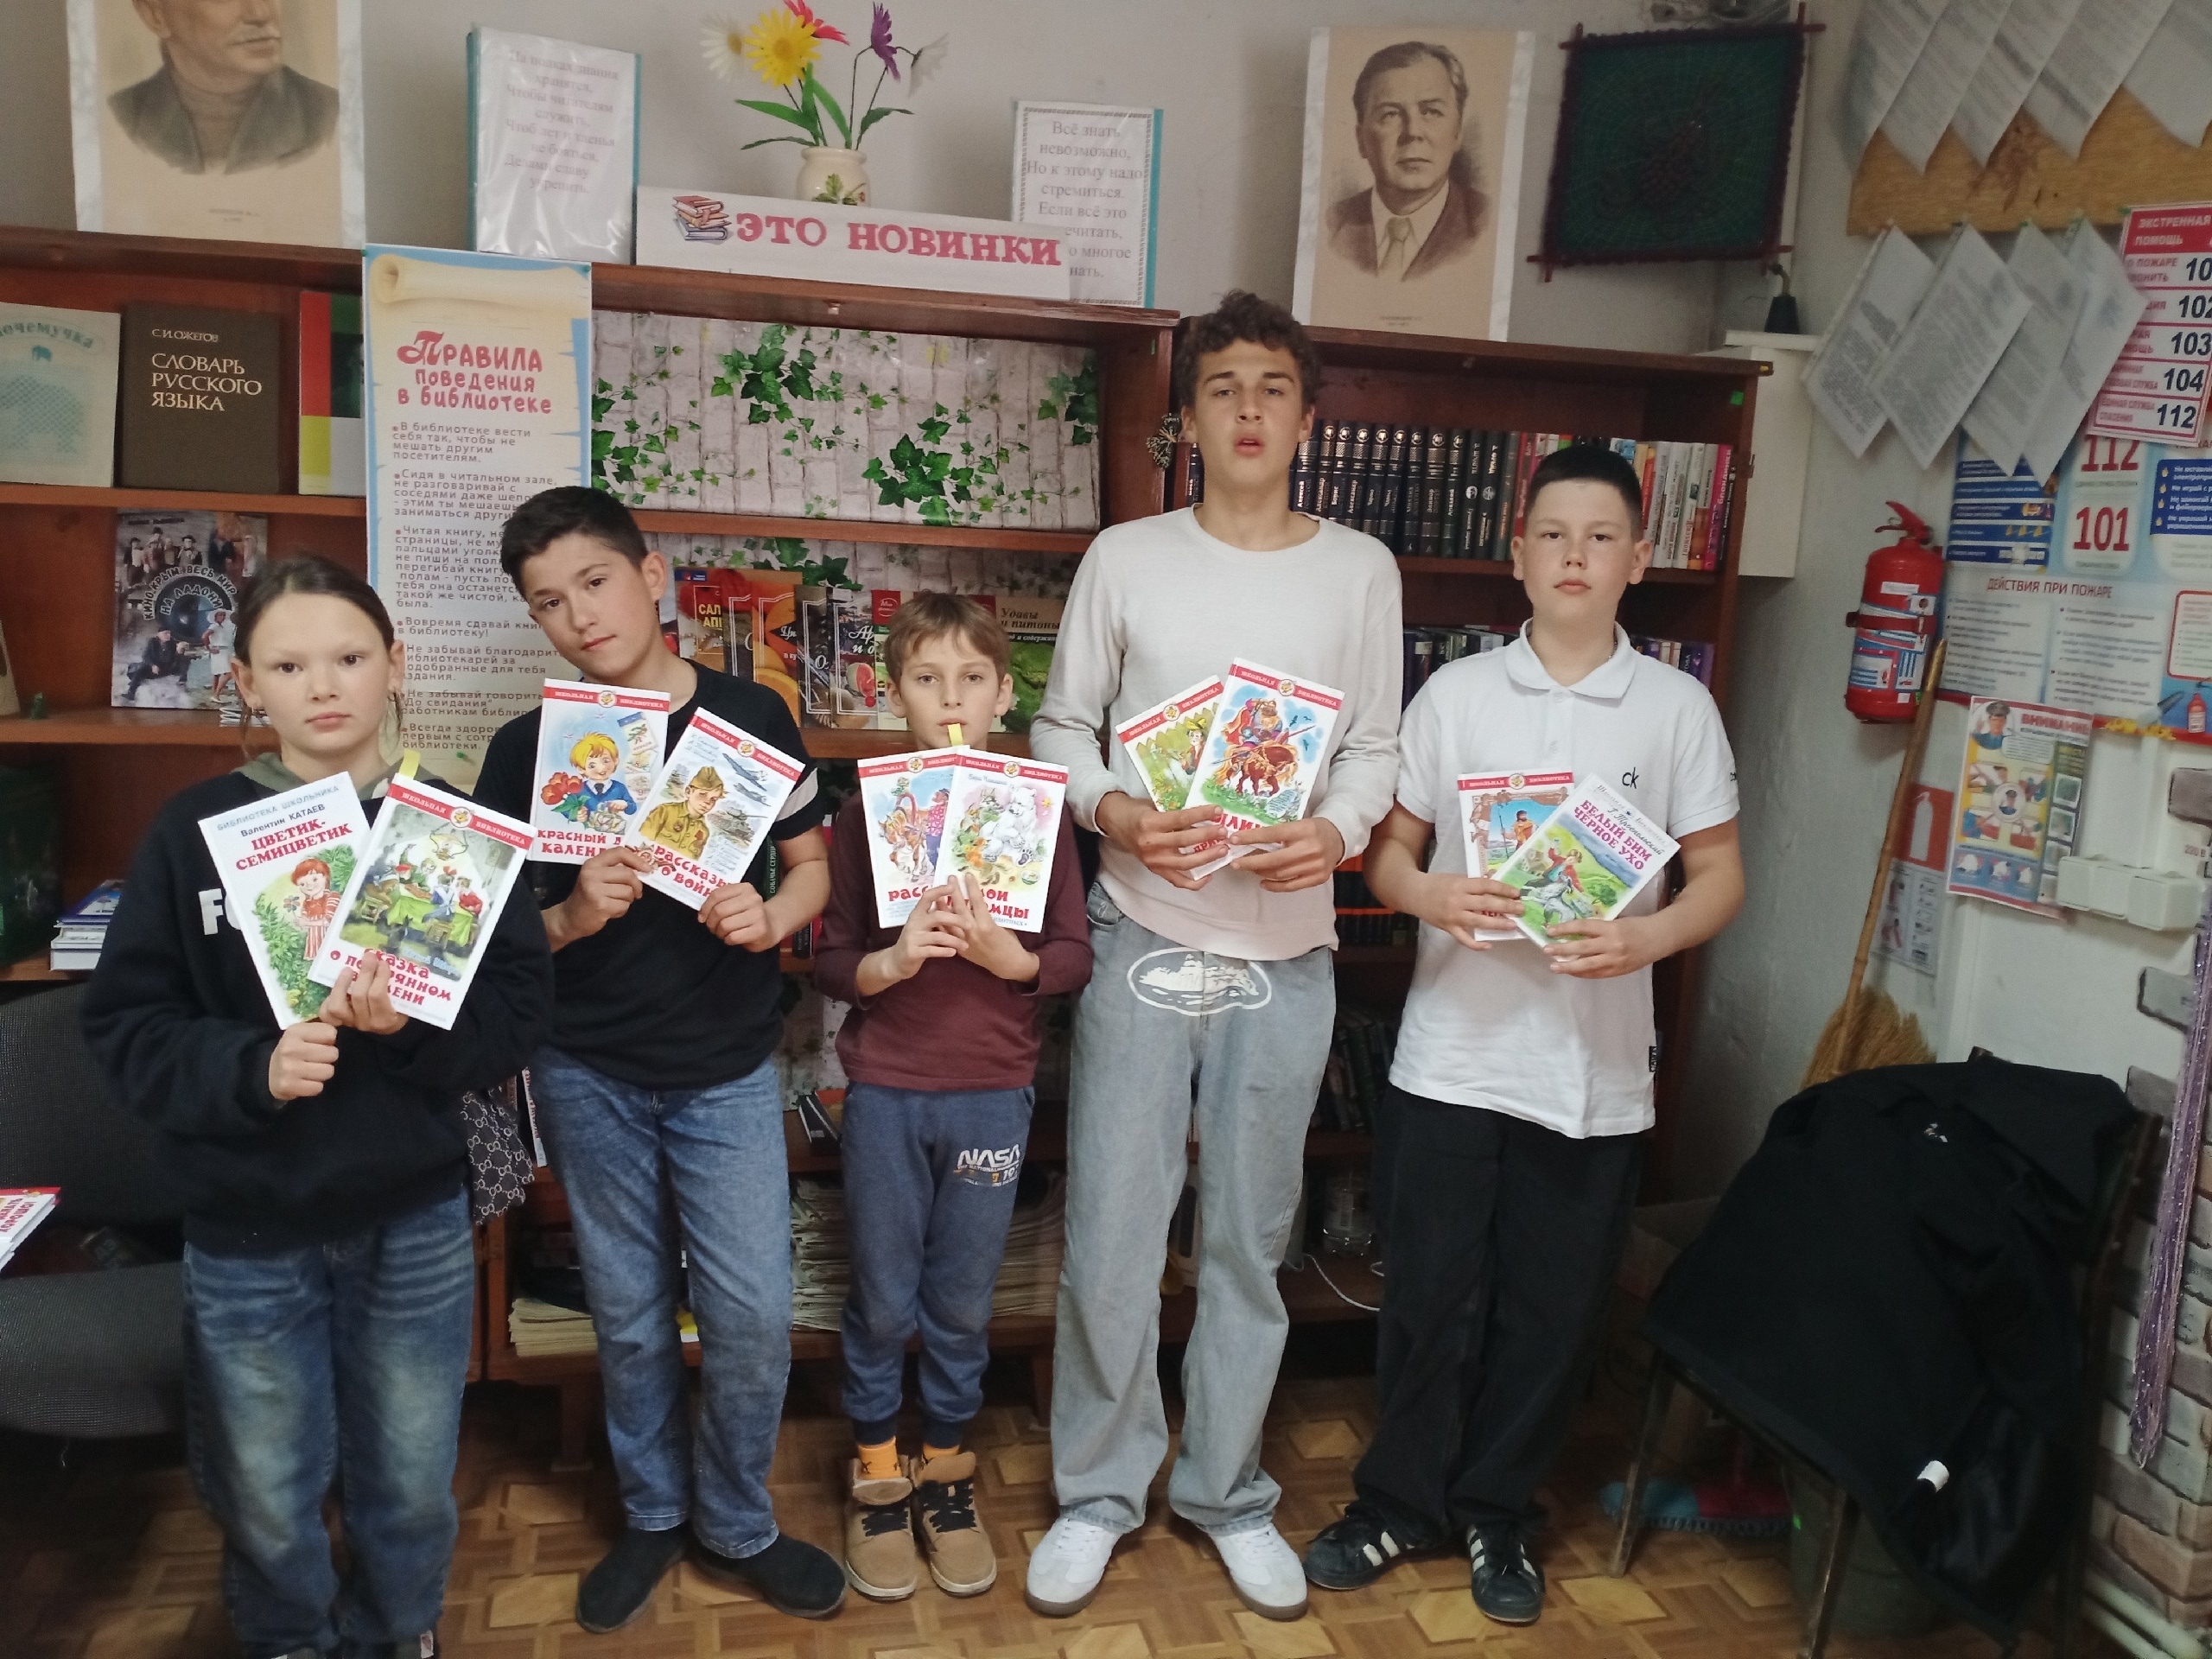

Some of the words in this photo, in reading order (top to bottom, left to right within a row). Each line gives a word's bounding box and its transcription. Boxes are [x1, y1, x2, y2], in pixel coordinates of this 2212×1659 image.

[507, 84, 546, 101] Чтобы
[506, 118, 536, 133] Чтоб
[1052, 121, 1078, 136] Всё
[1082, 125, 1121, 137] знать
[1039, 144, 1131, 159] невозможно,
[1027, 161, 1046, 175] Но
[1051, 165, 1059, 175] к
[1064, 166, 1104, 181] этому
[1109, 168, 1143, 180] надо
[1039, 201, 1072, 216] Если
[1077, 206, 1100, 218] всё
[1104, 207, 1127, 219] это
[2139, 214, 2212, 228] ЭКСТРЕННАЯ
[736, 213, 828, 247] ЭТО
[848, 221, 1062, 266] НОВИНКИ
[2135, 234, 2183, 246] ПОМОЩЬ
[1082, 246, 1131, 258] многое
[2186, 257, 2212, 282] 10
[397, 330, 543, 372] ПРАВИЛА
[2171, 331, 2212, 356] 103
[152, 353, 245, 375] СЛОВАРЬ
[152, 372, 262, 396] РУССКОГО
[416, 369, 536, 392] поведения
[2164, 368, 2204, 391] 104
[152, 392, 225, 412] ЯЗЫКА
[397, 388, 410, 404] в
[421, 385, 552, 414] библиотеке
[2157, 404, 2196, 429] 112
[401, 422, 408, 431] В
[413, 422, 490, 435] библиотеке
[495, 428, 531, 437] вести
[392, 432, 423, 441] себя
[427, 434, 452, 443] так,
[457, 435, 496, 445] чтобы
[393, 442, 442, 452] мешать
[447, 444, 493, 456] другим
[393, 451, 481, 462] посетителям.
[2082, 434, 2139, 472] 112
[402, 468, 433, 480] Сидя
[451, 473, 520, 483] читальном
[525, 476, 557, 486] зале,
[414, 480, 505, 492] разговаривай
[395, 489, 456, 499] соседями
[461, 492, 493, 501] даже
[1316, 477, 1325, 512] Александр
[1348, 480, 1357, 514] Александр
[403, 499, 434, 507] этим
[394, 507, 469, 518] заниматься
[404, 525, 440, 535] Читая
[446, 528, 485, 538] книгу,
[2074, 507, 2129, 551] 101
[395, 536, 461, 547] страницы,
[396, 544, 458, 556] пальцами
[463, 548, 501, 557] уголк
[416, 555, 449, 563] пиши
[396, 563, 465, 573] перегибай
[186, 564, 215, 579] ВЕСЬ
[217, 573, 238, 595] МИР
[397, 581, 424, 589] тебя
[400, 572, 440, 581] полам
[454, 575, 489, 584] пусть
[1987, 577, 2040, 592] ДЕЙСТВИЯ
[2044, 582, 2068, 594] ПРИ
[2071, 583, 2113, 599] ПОЖАРЕ
[160, 597, 175, 617] НА
[174, 584, 224, 609] ЛАДОНИ
[397, 590, 433, 599] такой
[460, 592, 509, 602] чистой,
[397, 599, 432, 608] была.
[405, 617, 461, 628] Вовремя
[467, 620, 511, 629] сдавай
[1012, 620, 1060, 630] питоны
[410, 626, 489, 639] библиотеку!
[428, 645, 481, 655] забывай
[407, 653, 498, 664] иблиотекарей
[404, 672, 456, 681] здания.
[407, 664, 487, 674] одобранные
[429, 691, 481, 701] забывай
[486, 692, 543, 702] говорить
[410, 723, 451, 733] Всегда
[403, 733, 451, 742] первым
[403, 741, 481, 750] библиотеки.
[217, 805, 278, 831] БИБЛИОТЕКА
[282, 785, 340, 810] ШКОЛЬНИКА
[240, 817, 286, 837] Валентин
[289, 804, 326, 821] КАТАЕВ
[402, 791, 447, 814] ШКОЛЬНАЯ
[475, 821, 526, 845] БИБЛИОТЕКА
[251, 818, 327, 851] ЦВЕТИК-
[537, 830, 607, 844] красный
[1580, 799, 1624, 840] БЕЛЫЙ
[1624, 836, 1652, 862] БИМ
[236, 823, 353, 870] СЕМИЦВЕТИК
[1618, 845, 1645, 870] УХО
[661, 866, 671, 876] о
[673, 873, 712, 898] войн
[957, 1143, 1020, 1169] NASA
